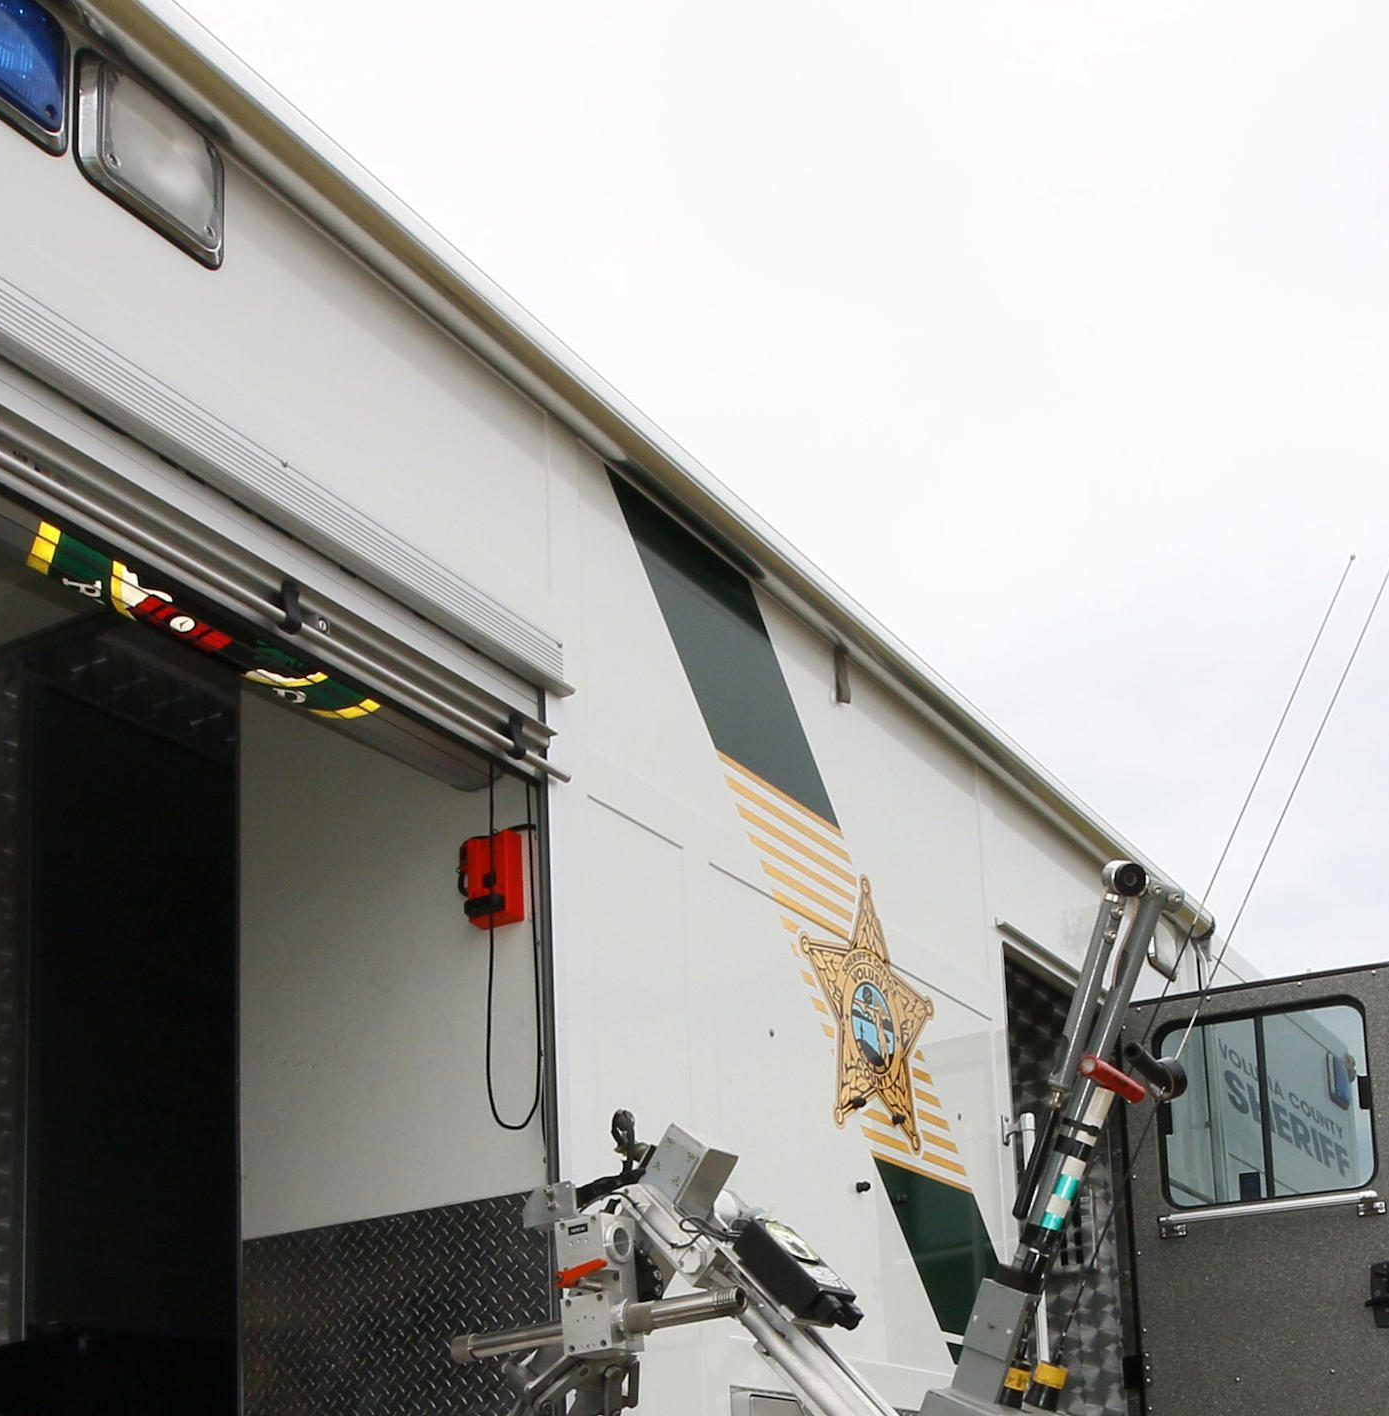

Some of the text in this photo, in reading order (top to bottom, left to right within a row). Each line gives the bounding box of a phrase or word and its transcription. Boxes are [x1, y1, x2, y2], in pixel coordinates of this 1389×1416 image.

[851, 967, 889, 1000] VOLUSIA
[1218, 1038, 1343, 1139] VOLUIA COUNTY
